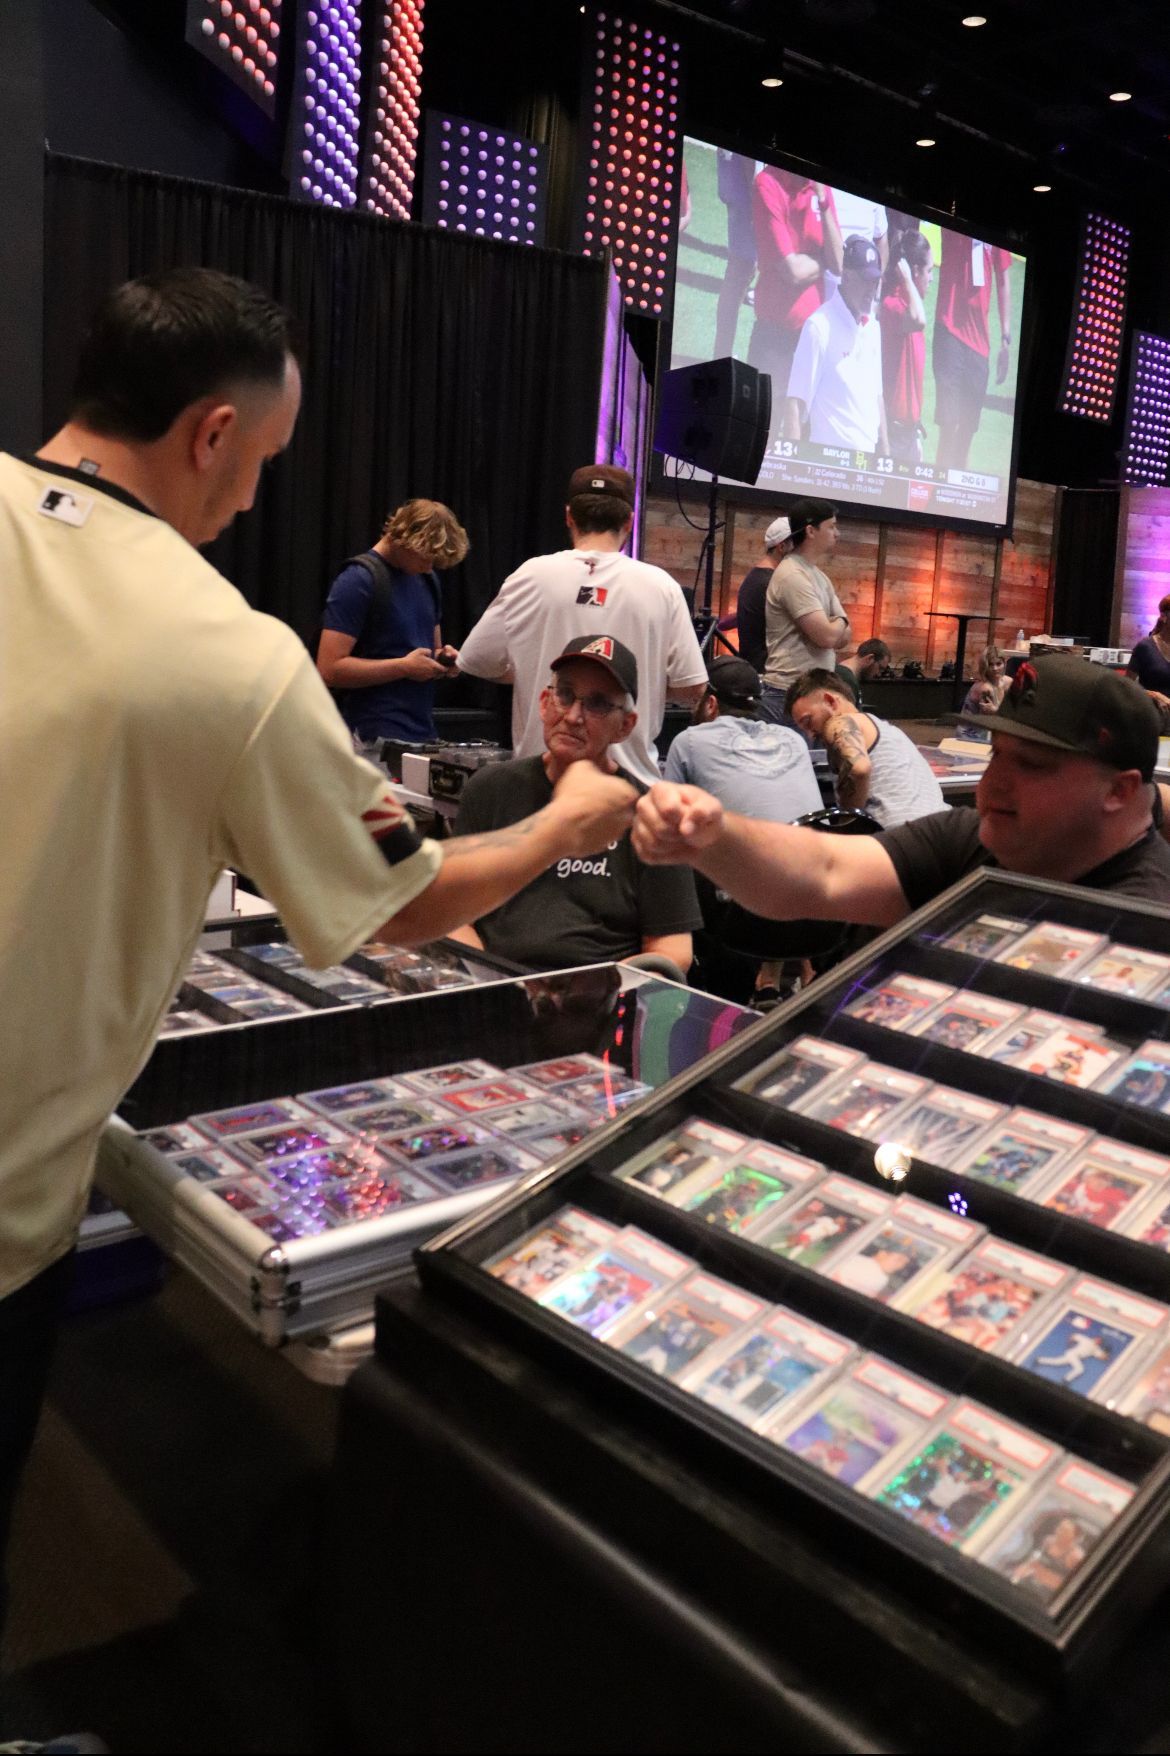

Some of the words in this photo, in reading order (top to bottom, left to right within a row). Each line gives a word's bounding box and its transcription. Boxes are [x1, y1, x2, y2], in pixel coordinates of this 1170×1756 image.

[774, 441, 793, 457] 13
[823, 448, 850, 459] BAYLOR
[877, 458, 894, 473] 13
[915, 466, 934, 479] 0:42
[557, 857, 611, 878] good.
